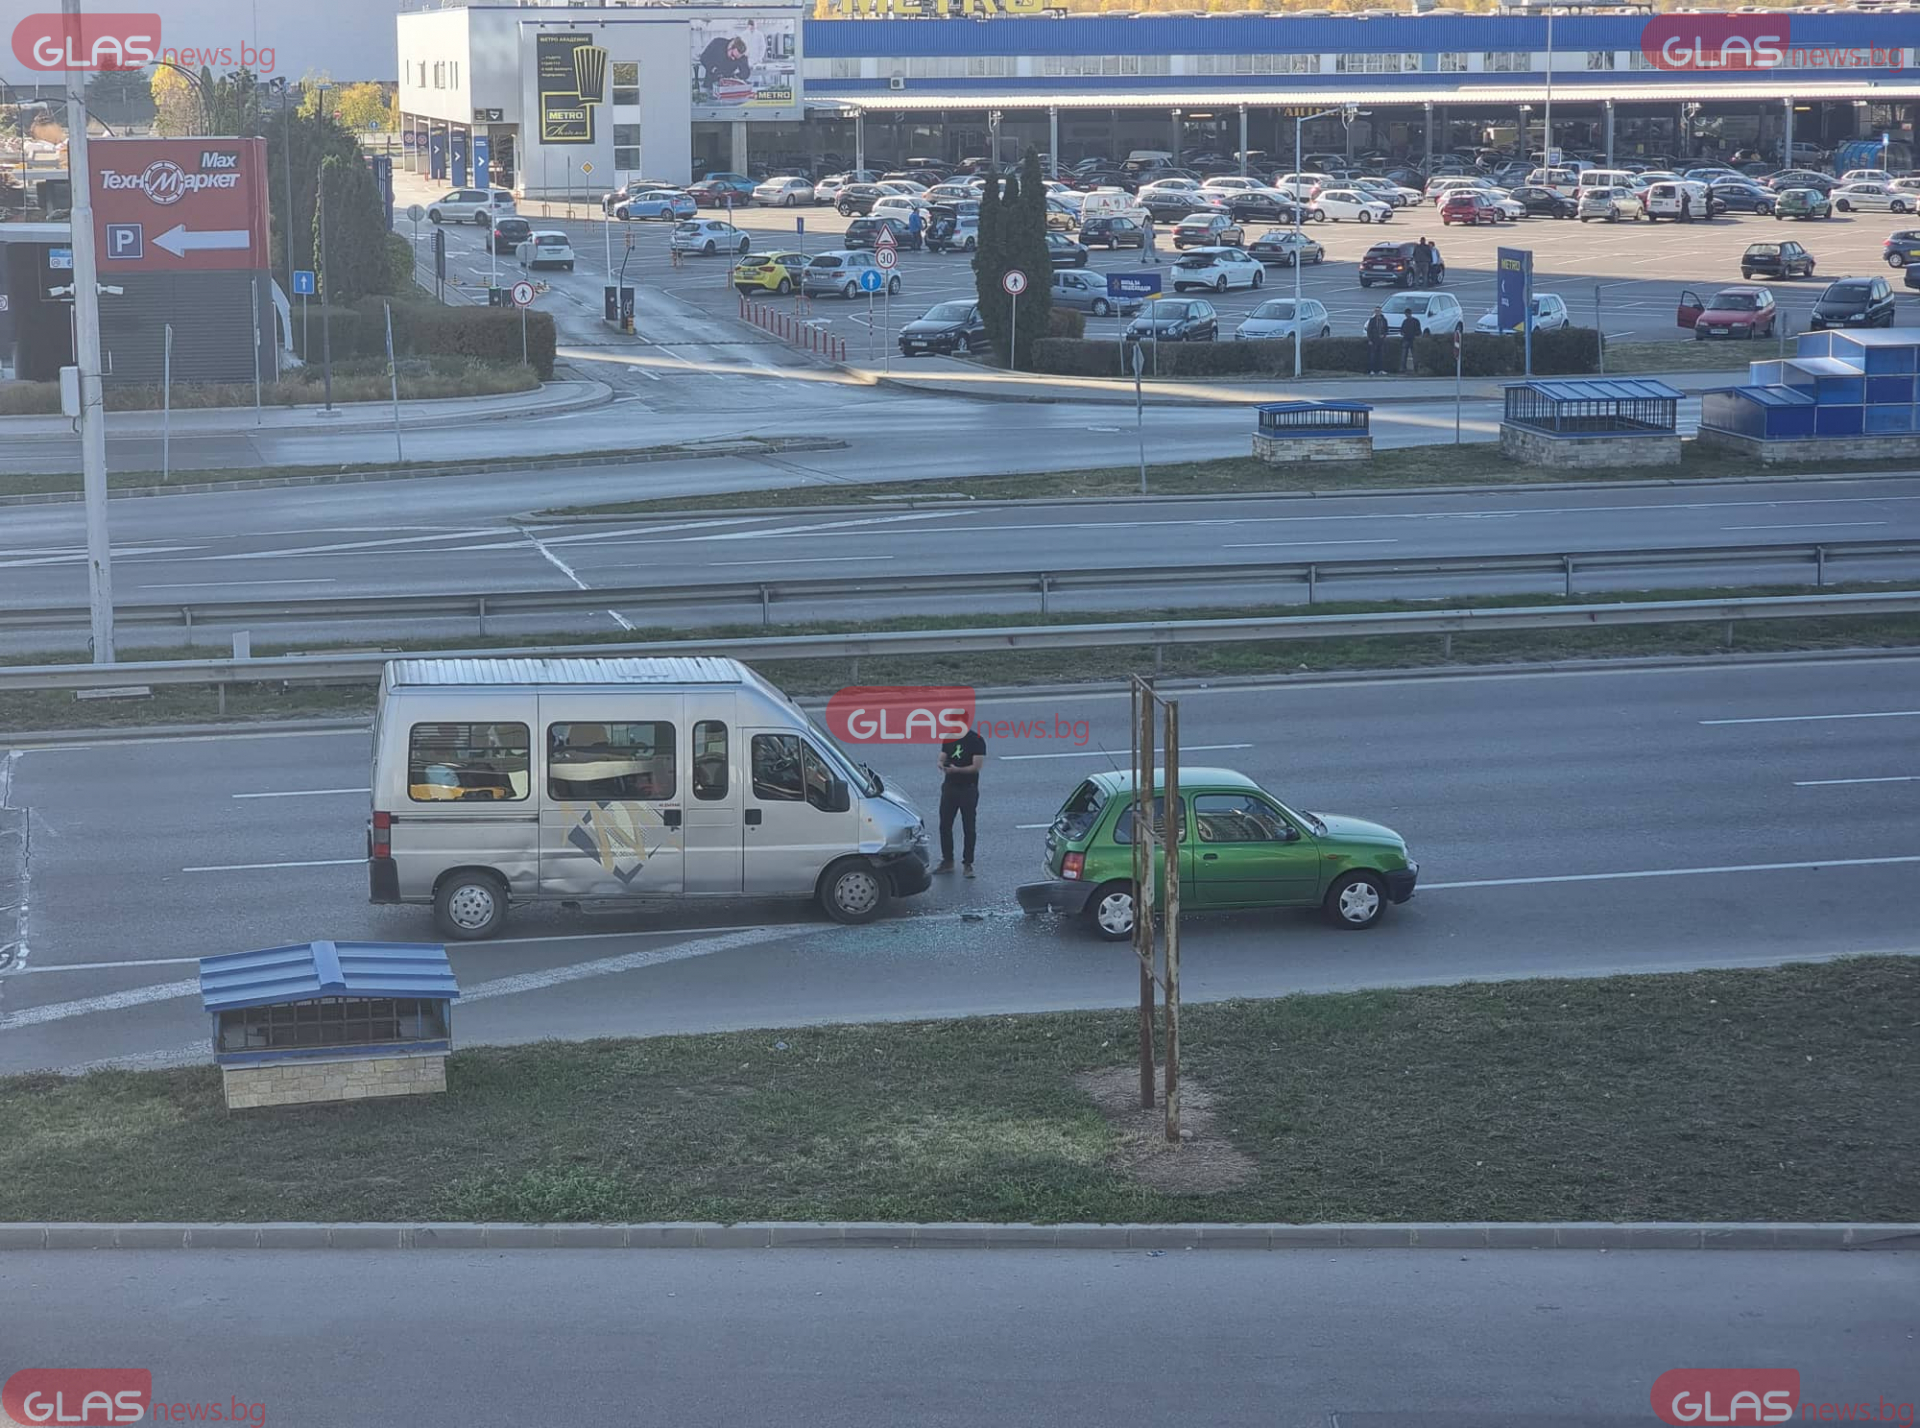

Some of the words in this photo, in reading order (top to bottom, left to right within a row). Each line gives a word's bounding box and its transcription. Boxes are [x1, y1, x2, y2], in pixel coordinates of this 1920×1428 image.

[758, 91, 791, 99] METRO
[549, 111, 584, 120] METRO
[201, 152, 237, 168] Max
[880, 252, 893, 264] 30
[1501, 258, 1521, 271] METRO
